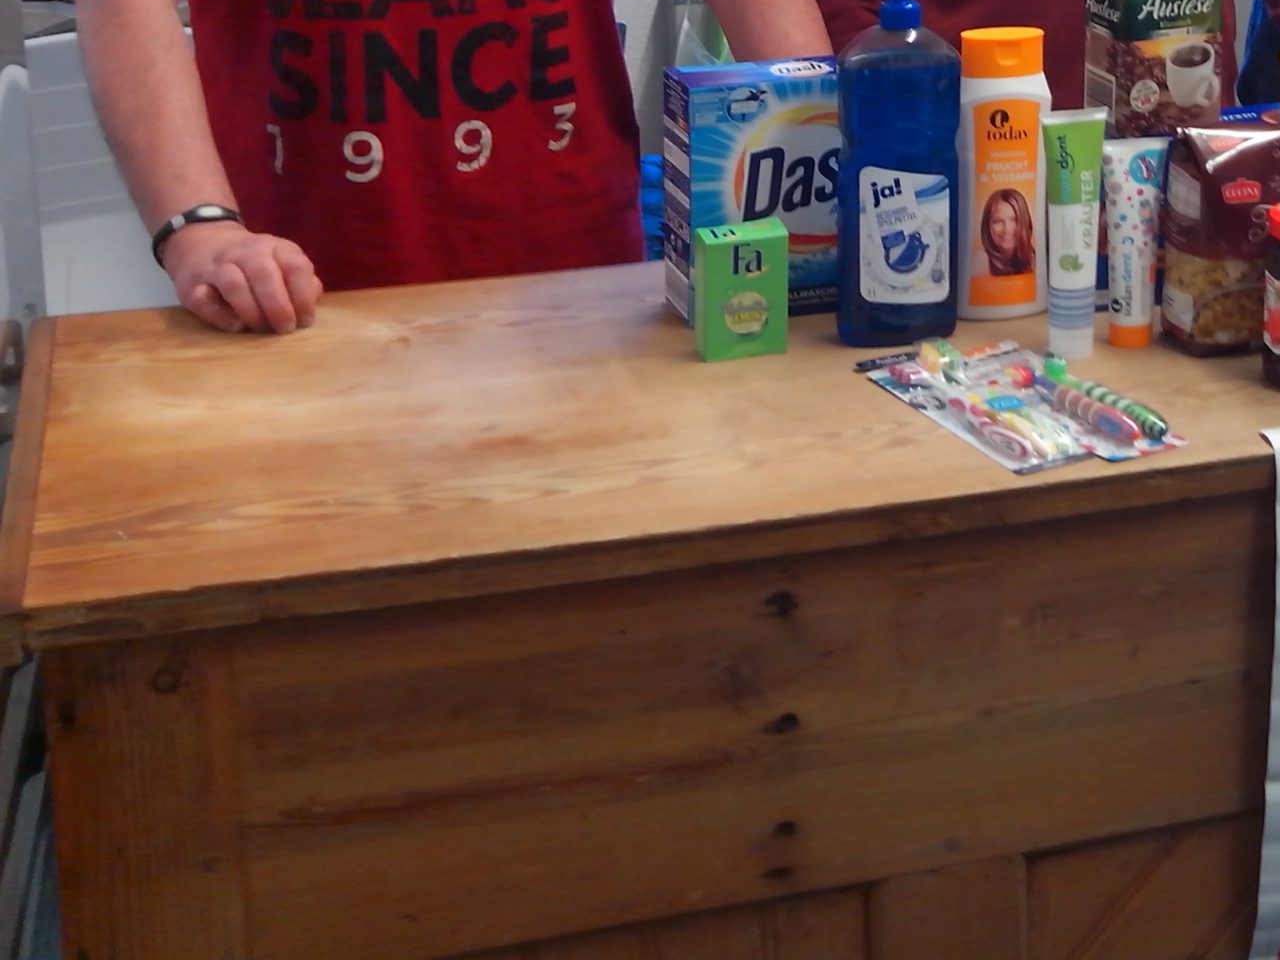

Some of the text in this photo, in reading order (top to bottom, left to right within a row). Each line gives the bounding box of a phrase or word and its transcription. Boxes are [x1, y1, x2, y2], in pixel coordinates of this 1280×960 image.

[267, 10, 578, 125] SINCE
[266, 102, 577, 183] 1993
[987, 125, 1028, 141] today
[742, 146, 840, 223] Das
[870, 177, 903, 209] ja!
[732, 242, 763, 276] Fa
